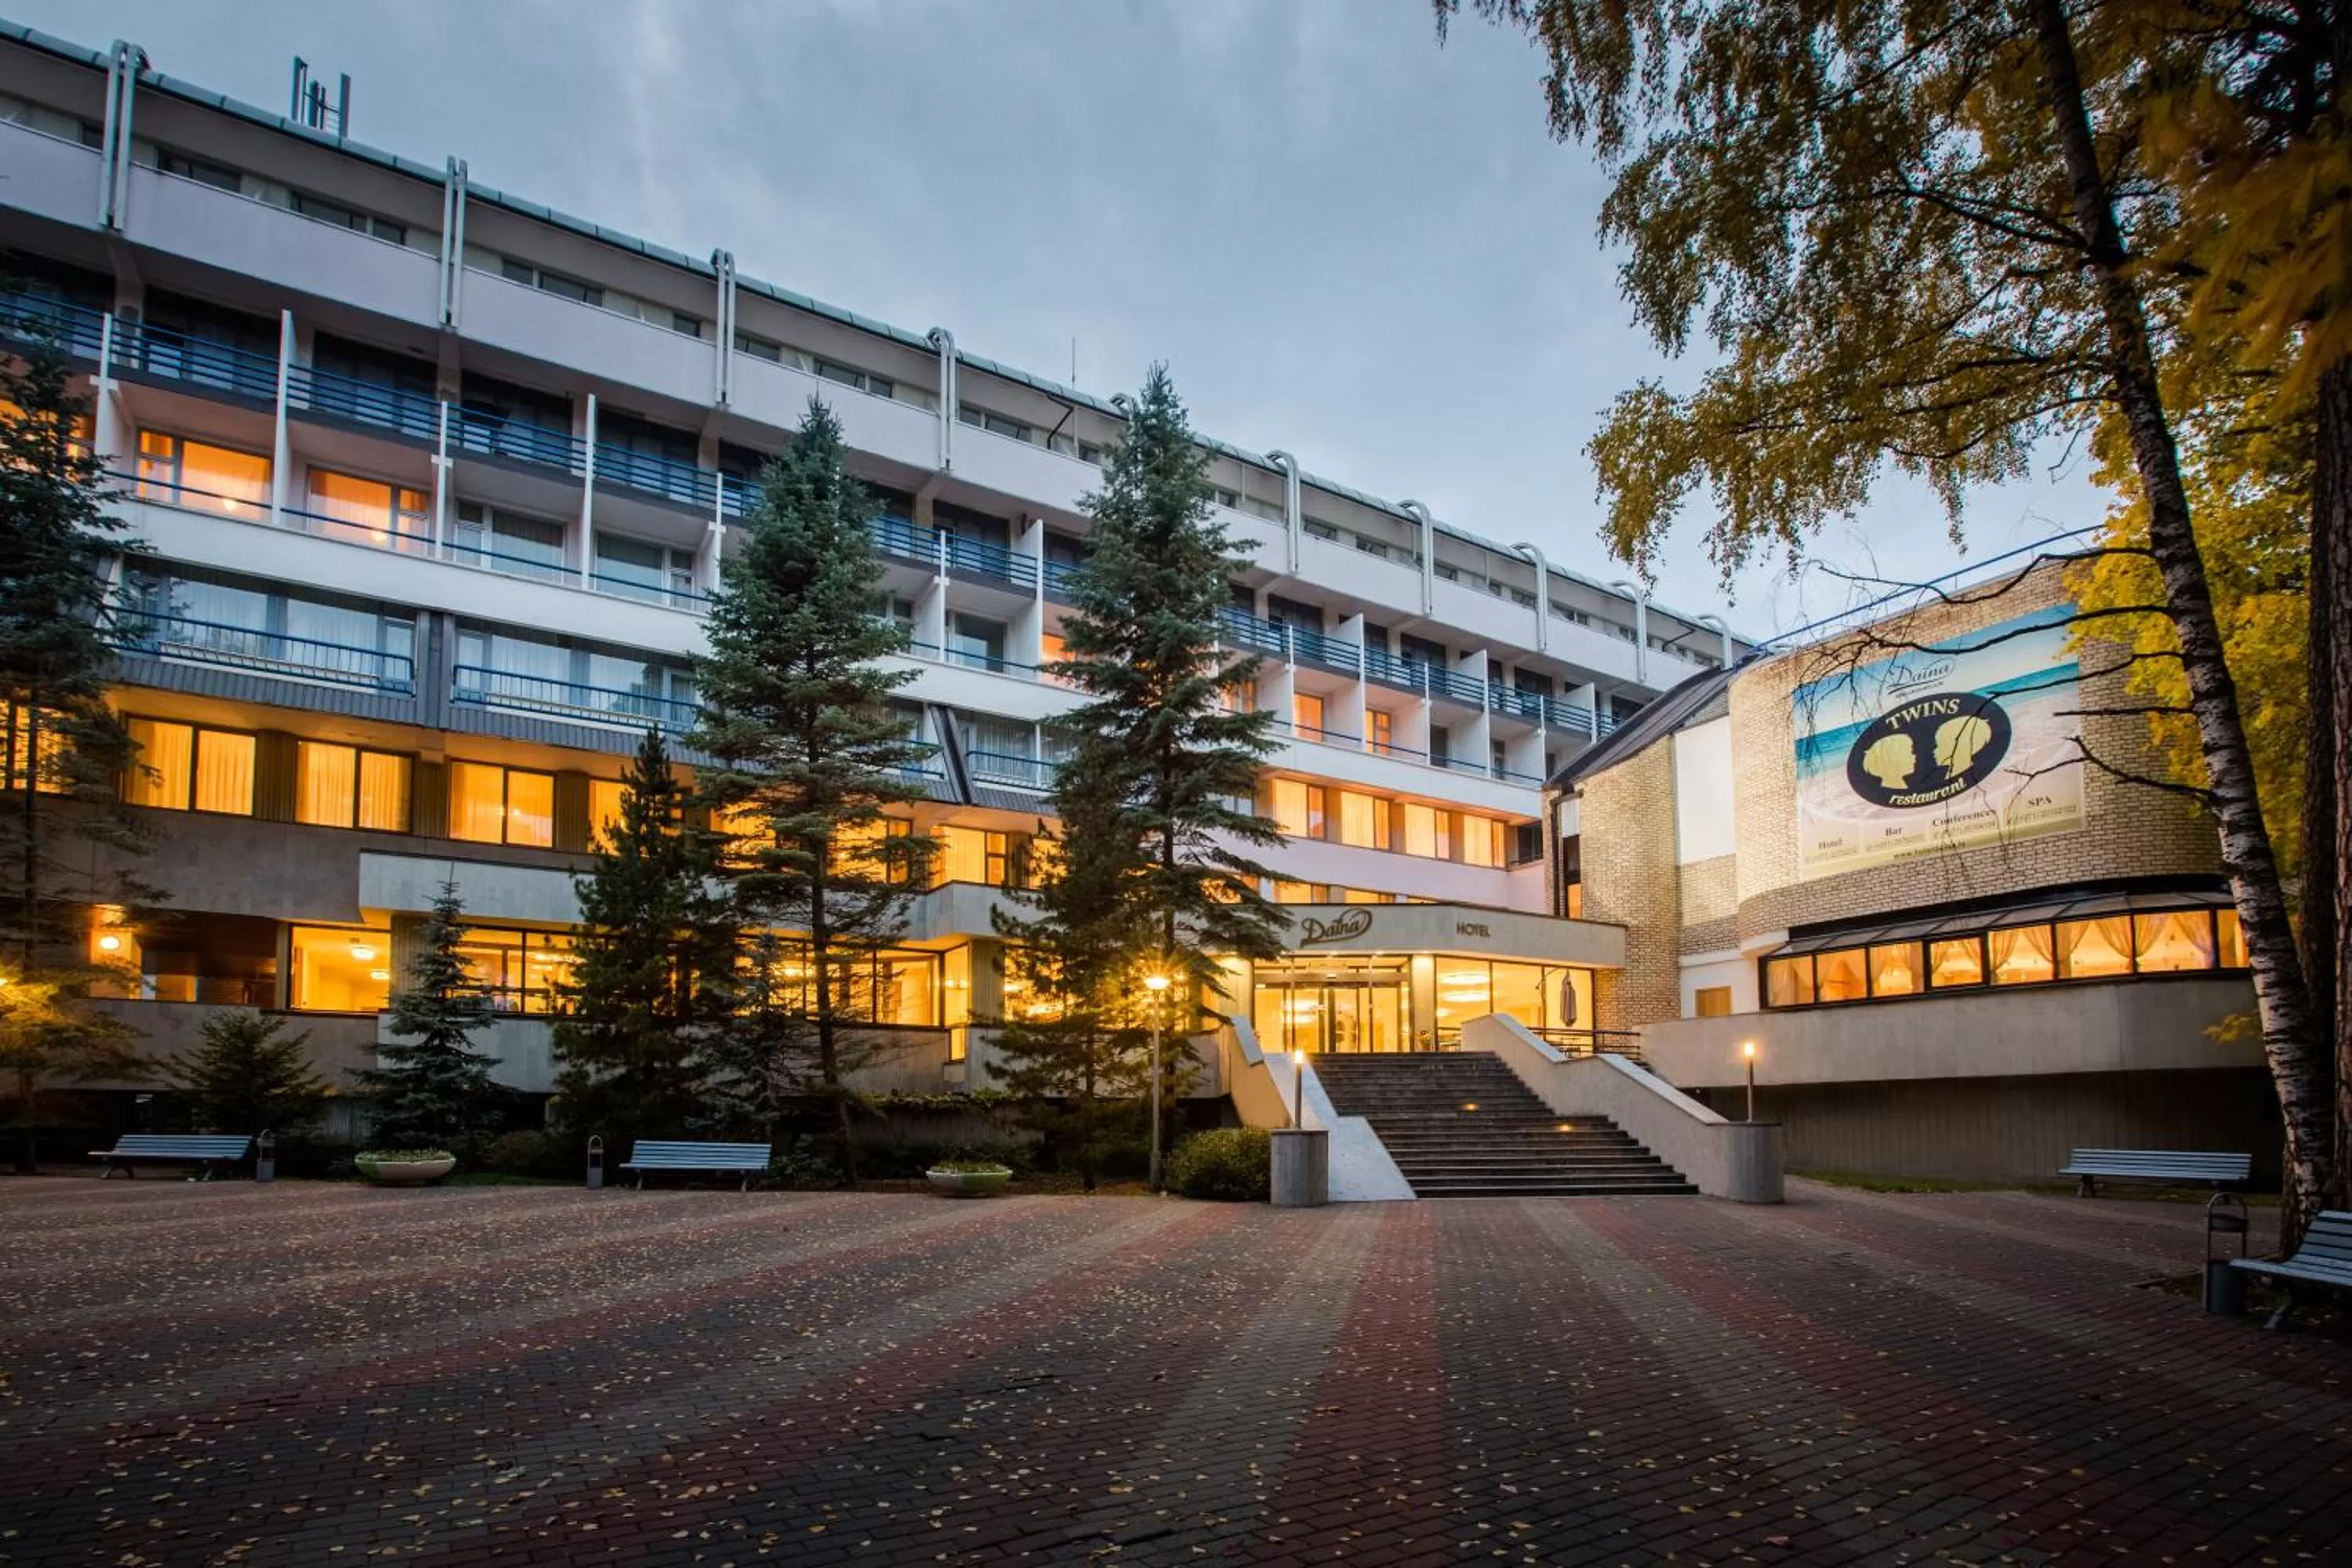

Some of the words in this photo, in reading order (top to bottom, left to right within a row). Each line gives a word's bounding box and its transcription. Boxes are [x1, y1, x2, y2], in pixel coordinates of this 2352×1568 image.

[1887, 657, 1956, 694] Daina
[1885, 699, 1960, 729] TWINS
[1889, 777, 1966, 804] restaurant
[2027, 796, 2052, 807] SPA
[1885, 827, 1903, 837] Bar
[1818, 837, 1843, 850] Hotel
[1300, 908, 1373, 948] Daina
[1456, 921, 1491, 938] HOTEL
